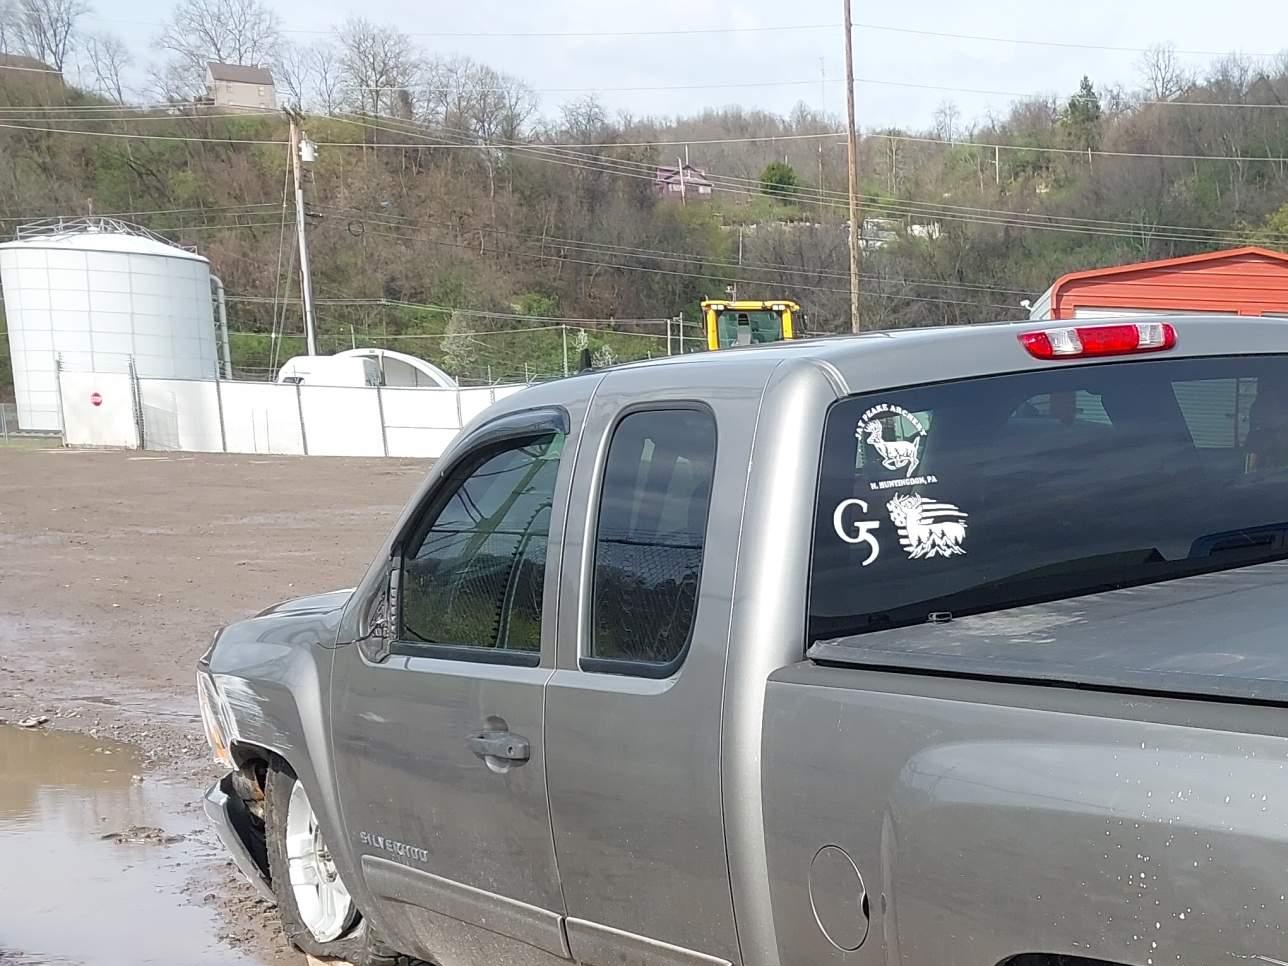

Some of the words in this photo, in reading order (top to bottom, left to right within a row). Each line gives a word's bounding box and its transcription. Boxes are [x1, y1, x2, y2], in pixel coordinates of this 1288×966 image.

[855, 419, 866, 440] JAY
[862, 403, 889, 422] PEAKE
[889, 404, 928, 437] ARCHERY
[926, 475, 938, 485] PA
[833, 498, 881, 567] G5
